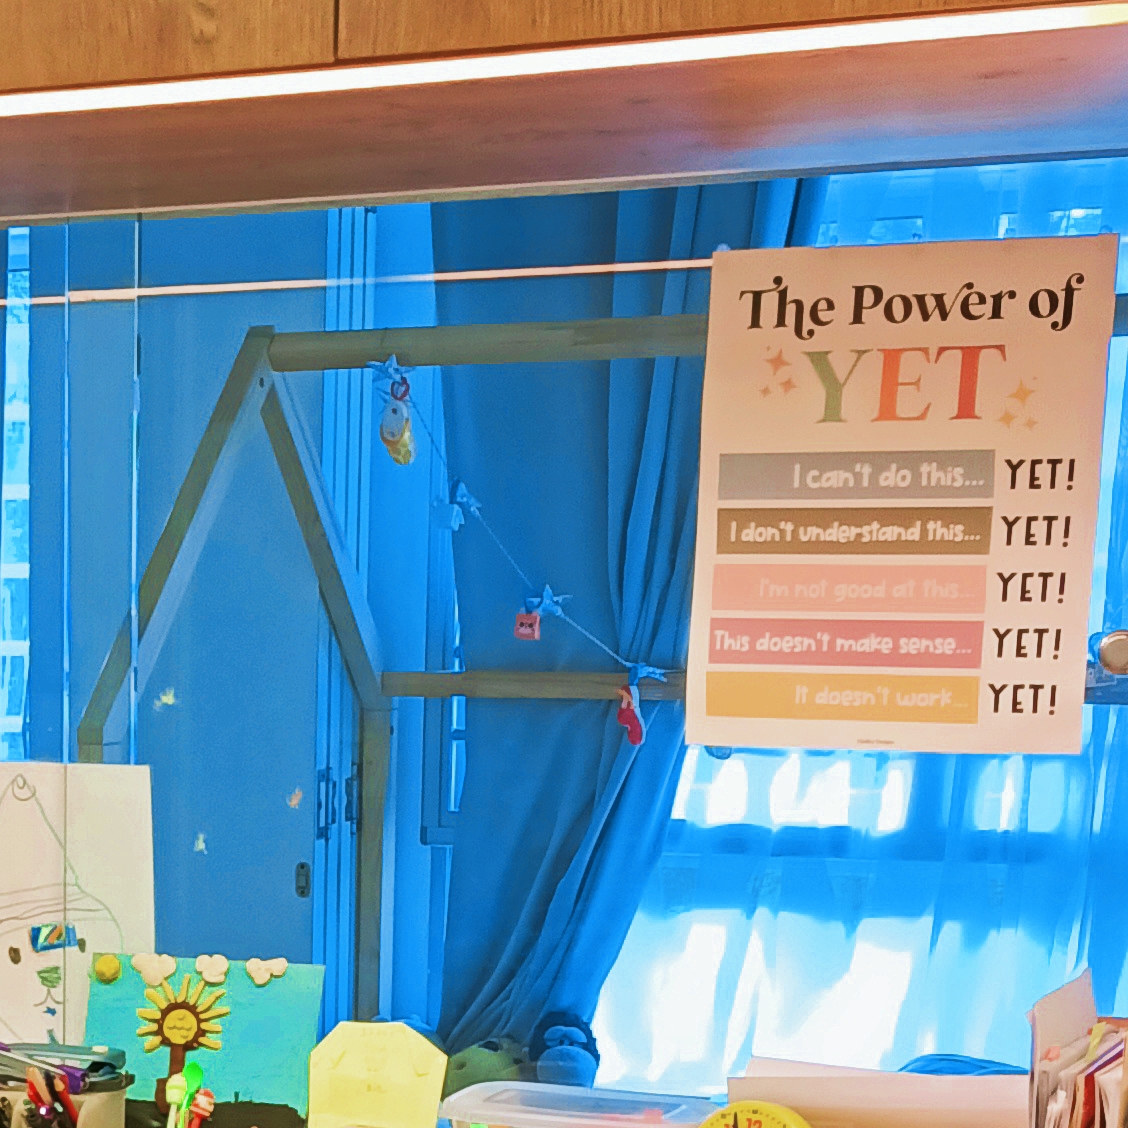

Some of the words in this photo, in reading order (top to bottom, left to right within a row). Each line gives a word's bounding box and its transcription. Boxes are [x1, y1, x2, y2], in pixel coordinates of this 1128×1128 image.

[739, 276, 835, 341] The
[848, 281, 1017, 326] Power
[1029, 272, 1084, 332] of
[802, 343, 1007, 425] YET
[793, 464, 800, 488] I
[806, 463, 872, 489] can't
[879, 462, 911, 488] do
[920, 461, 985, 487] this...
[1004, 458, 1076, 490] YET!
[730, 522, 736, 541] I
[741, 522, 794, 542] don't
[799, 521, 921, 543] understand
[926, 521, 981, 541] this...
[1000, 515, 1071, 547] YET!
[758, 577, 788, 598] I'm
[794, 579, 827, 598] not
[834, 578, 885, 603] good
[892, 579, 917, 598] at
[923, 579, 975, 598] this...
[996, 572, 1066, 604] YET!
[714, 629, 751, 652] This
[756, 631, 829, 653] doesn't
[835, 633, 893, 654] make
[899, 634, 972, 655] sense...
[992, 627, 1061, 660] YET!
[794, 686, 808, 703] It
[815, 686, 891, 707] doesn't
[988, 683, 1056, 714] YET!
